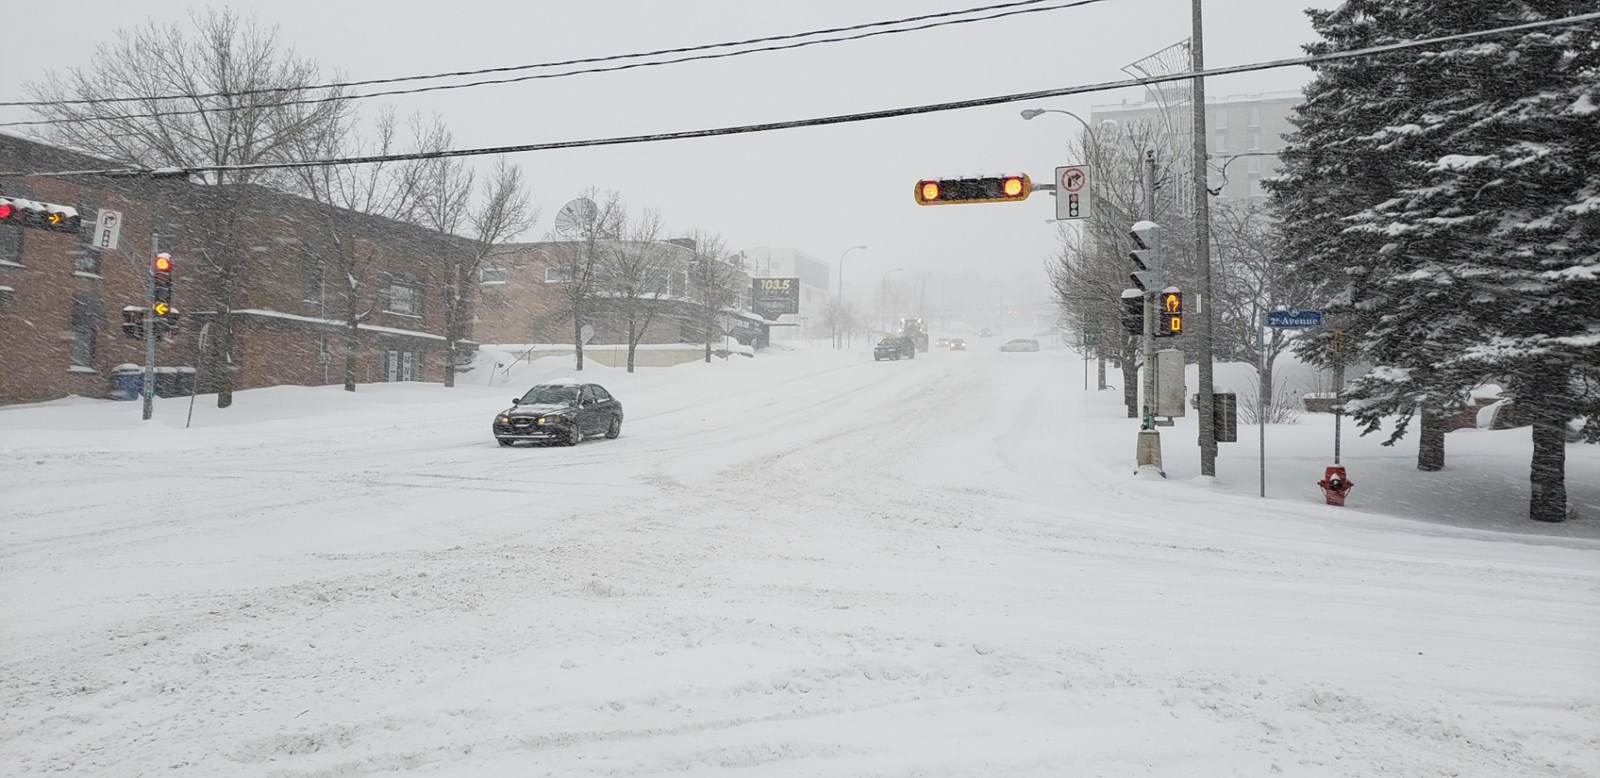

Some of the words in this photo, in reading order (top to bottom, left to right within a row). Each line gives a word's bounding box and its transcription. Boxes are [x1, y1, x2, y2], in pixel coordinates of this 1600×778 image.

[761, 279, 790, 290] 103.5
[1171, 317, 1181, 331] 0
[1282, 316, 1318, 325] Avenue
